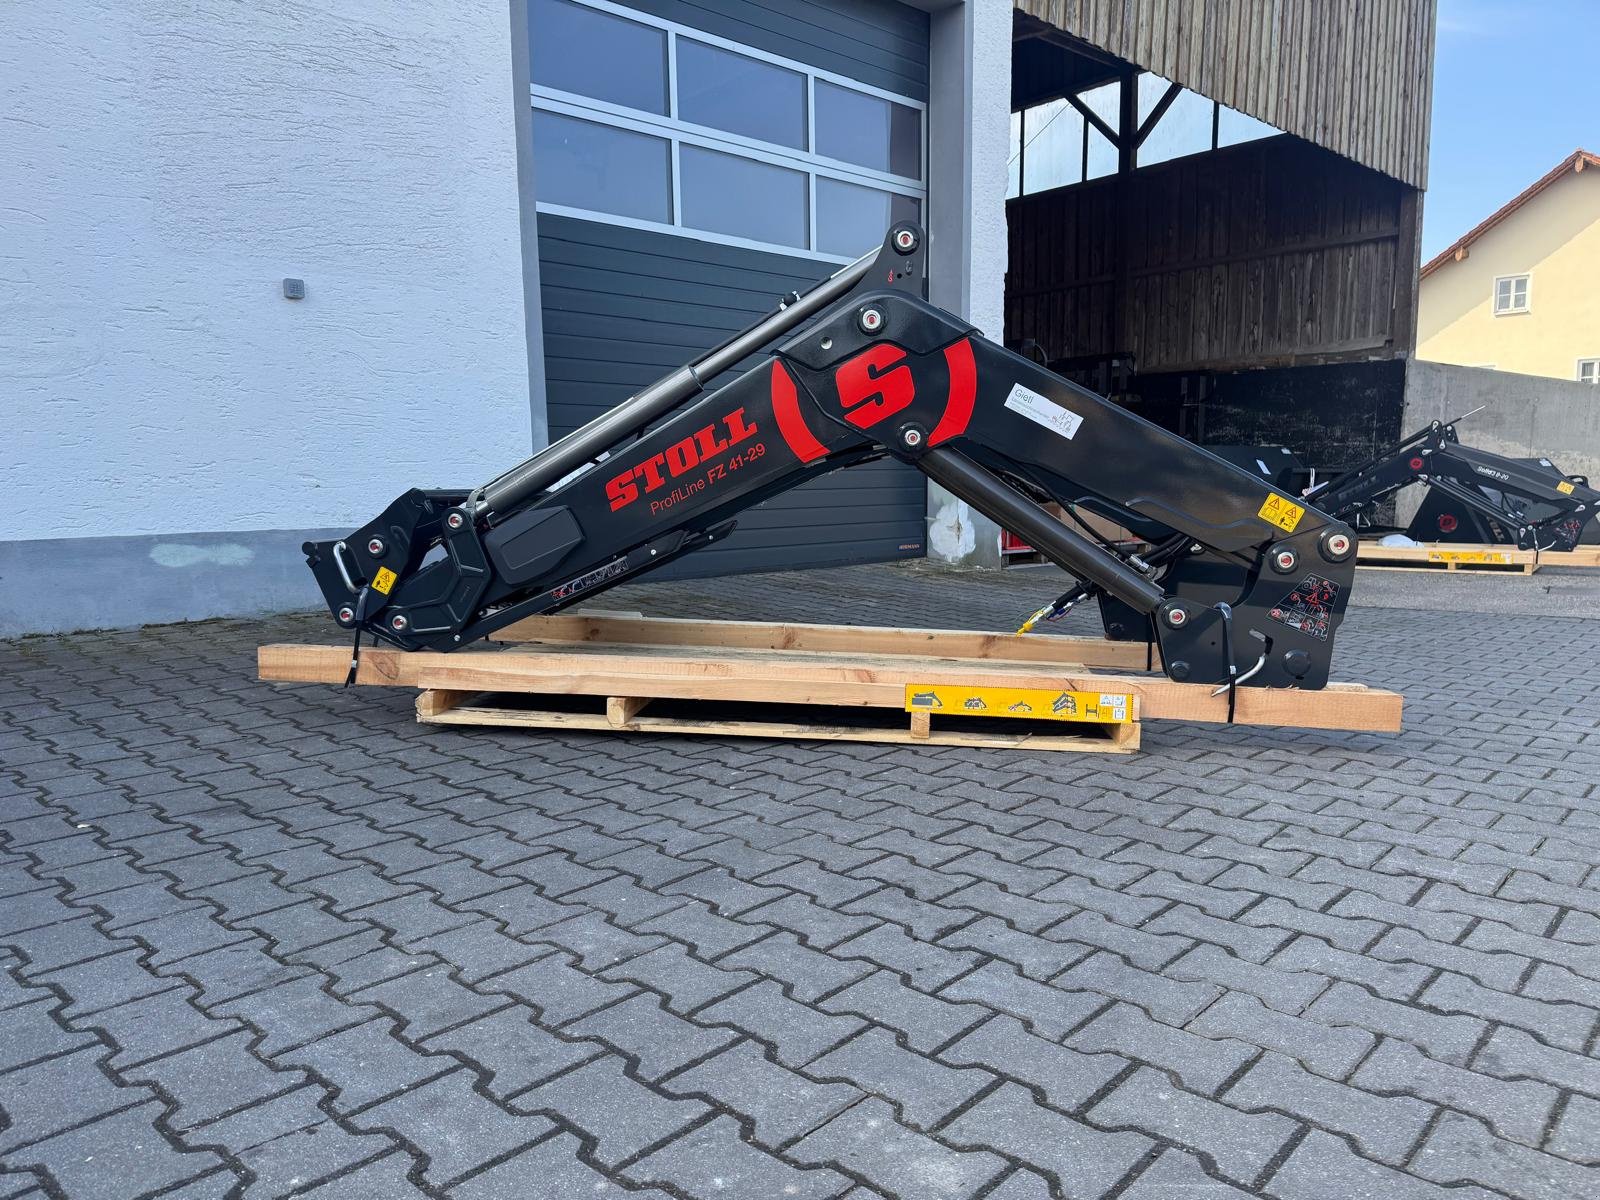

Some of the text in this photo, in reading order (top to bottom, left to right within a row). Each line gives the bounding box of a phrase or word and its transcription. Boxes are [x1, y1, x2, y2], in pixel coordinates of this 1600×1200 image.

[835, 343, 915, 429] S
[605, 406, 758, 513] STOLL
[650, 442, 766, 516] ProfiLine FZ 41-29
